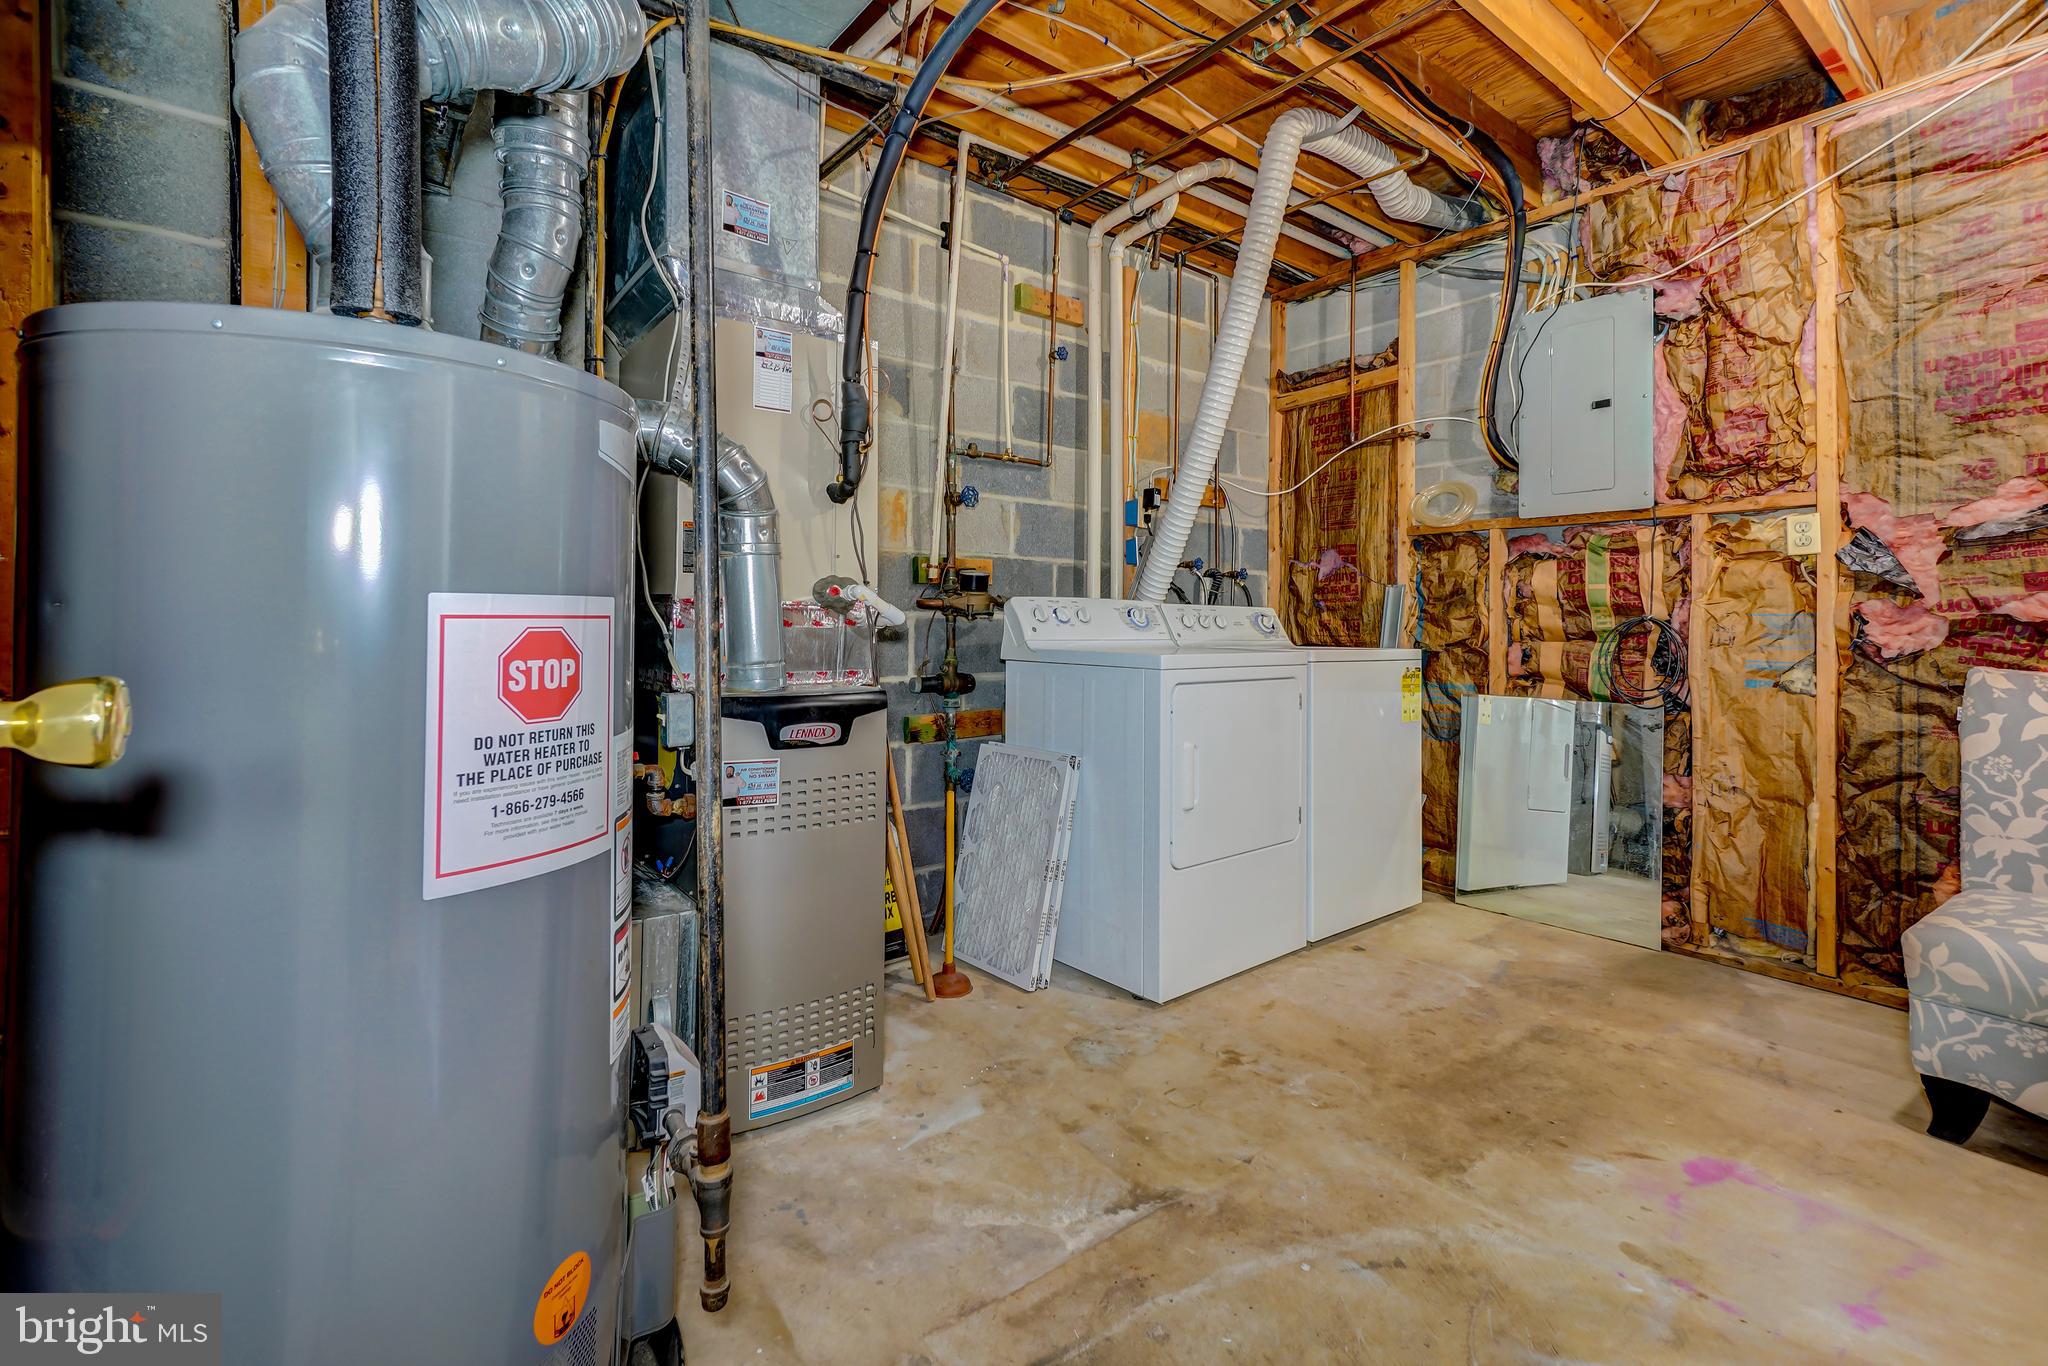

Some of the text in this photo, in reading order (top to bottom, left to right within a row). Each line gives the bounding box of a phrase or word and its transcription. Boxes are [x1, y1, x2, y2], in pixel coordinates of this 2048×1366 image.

[508, 658, 576, 692] STOP
[474, 723, 595, 750] DO NOT RETURN THIS
[789, 727, 828, 739] LENNOX
[483, 739, 590, 766] WATER HEATER TO
[456, 751, 603, 787] THE PLACE OF PURCHASE
[491, 788, 584, 818] 1-866-279-4566
[558, 808, 569, 816] days
[543, 1287, 553, 1299] DO
[554, 1276, 567, 1290] NOT
[566, 1258, 584, 1277] BLOCK
